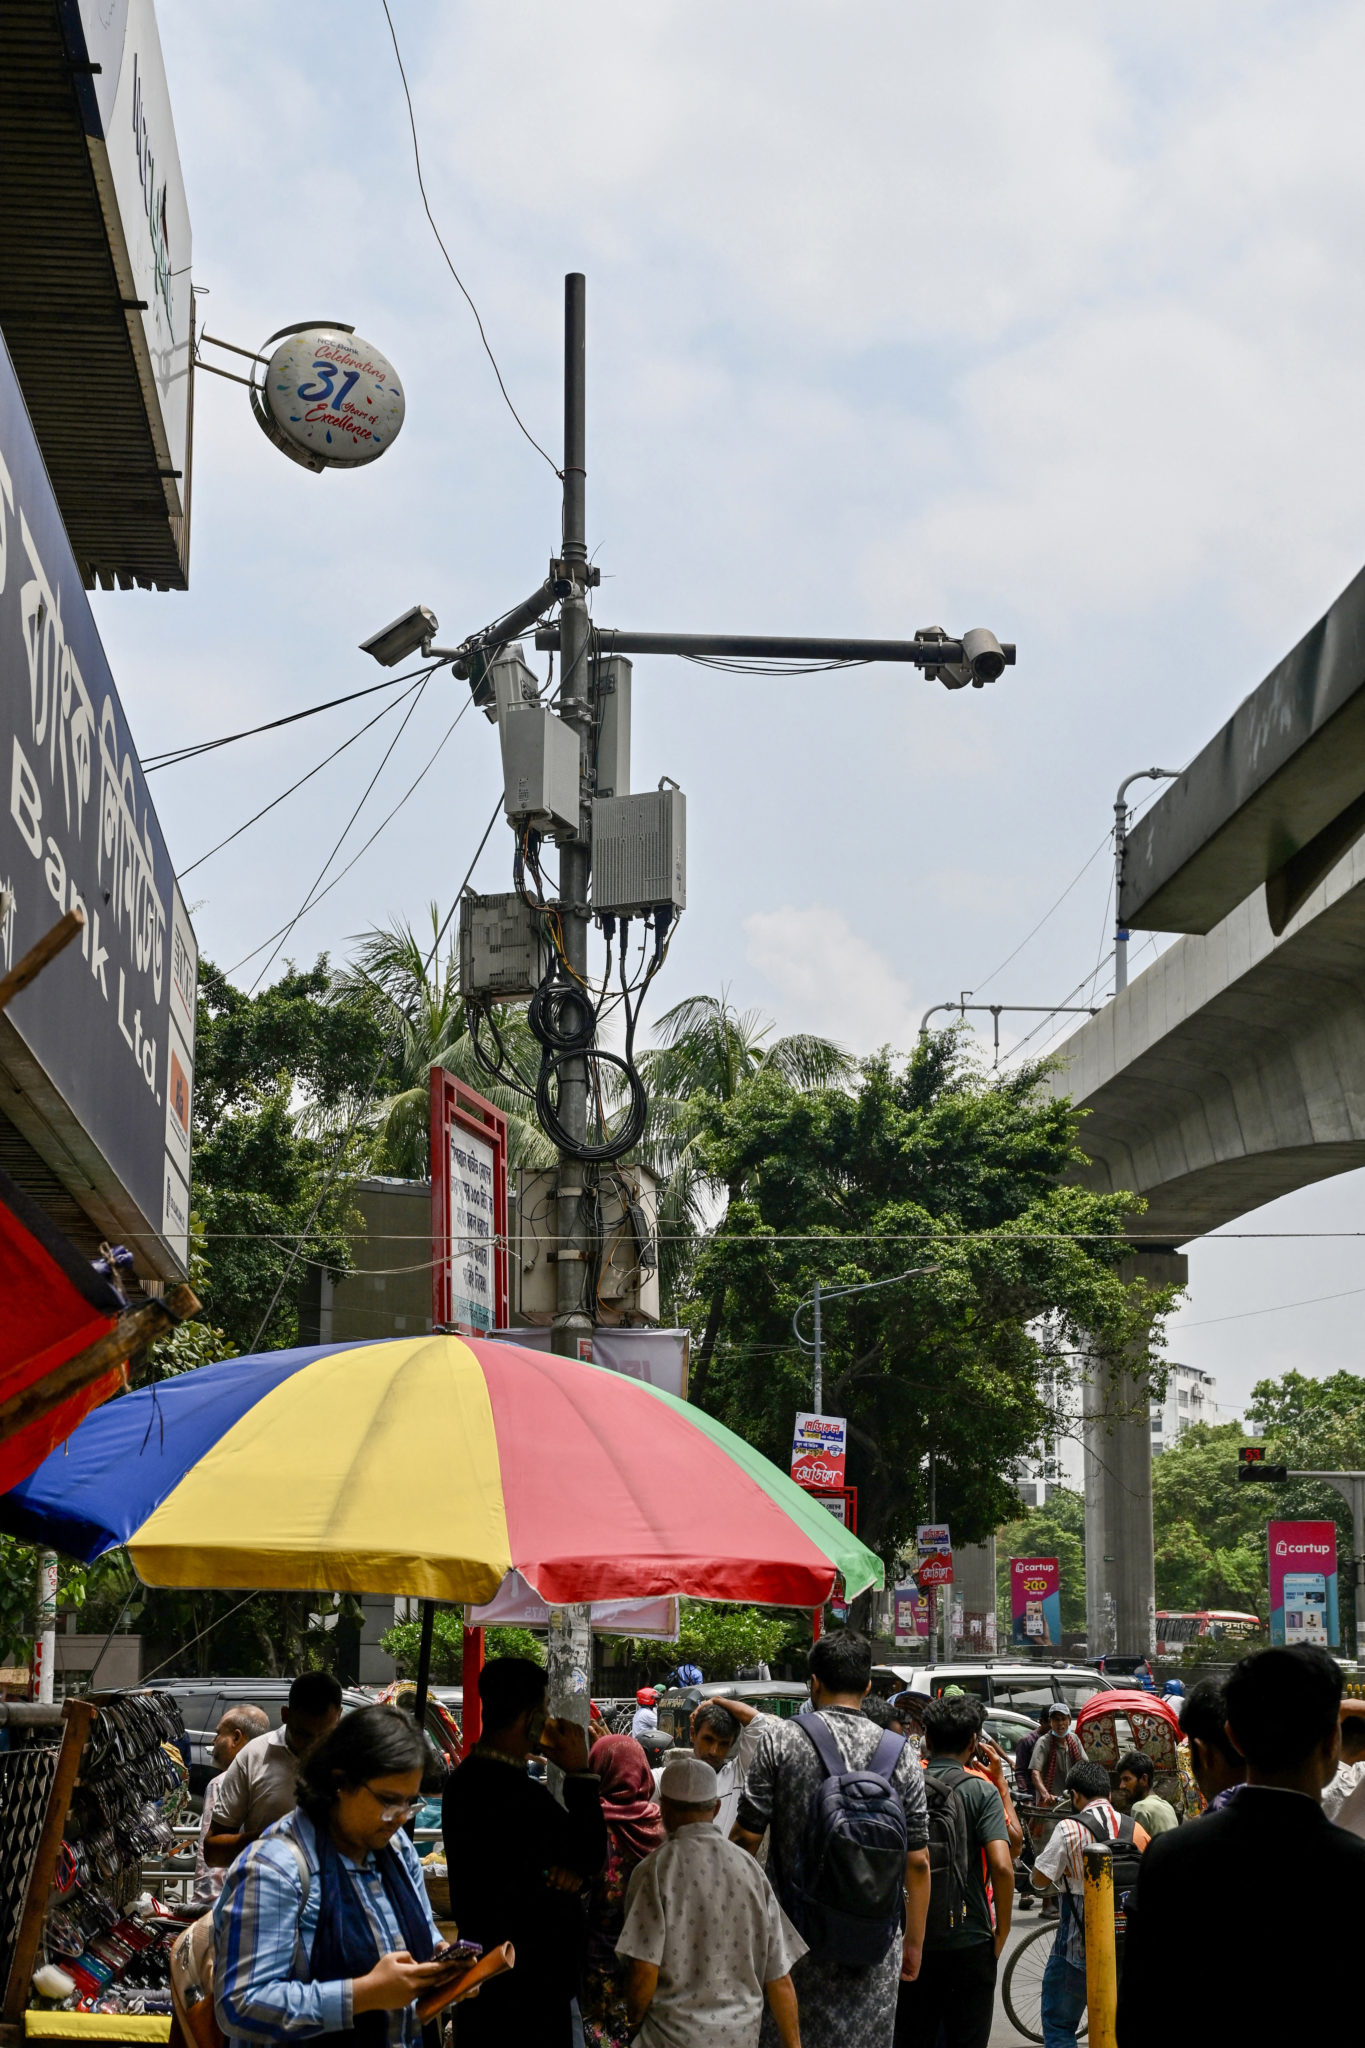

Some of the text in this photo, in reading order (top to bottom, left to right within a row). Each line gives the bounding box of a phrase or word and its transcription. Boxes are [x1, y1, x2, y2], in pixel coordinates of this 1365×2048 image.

[314, 345, 386, 383] Celebrating
[337, 344, 359, 356] Bank
[297, 361, 360, 411] 31
[305, 403, 372, 440] Excellence
[341, 402, 379, 425] Years of
[20, 506, 166, 1005] ব্যাংক লিমিটেড
[11, 735, 161, 1107] Bank Ltd.
[1288, 1543, 1330, 1555] cartup
[1024, 1563, 1054, 1573] cartup
[1024, 1580, 1048, 1591] ২৫০
